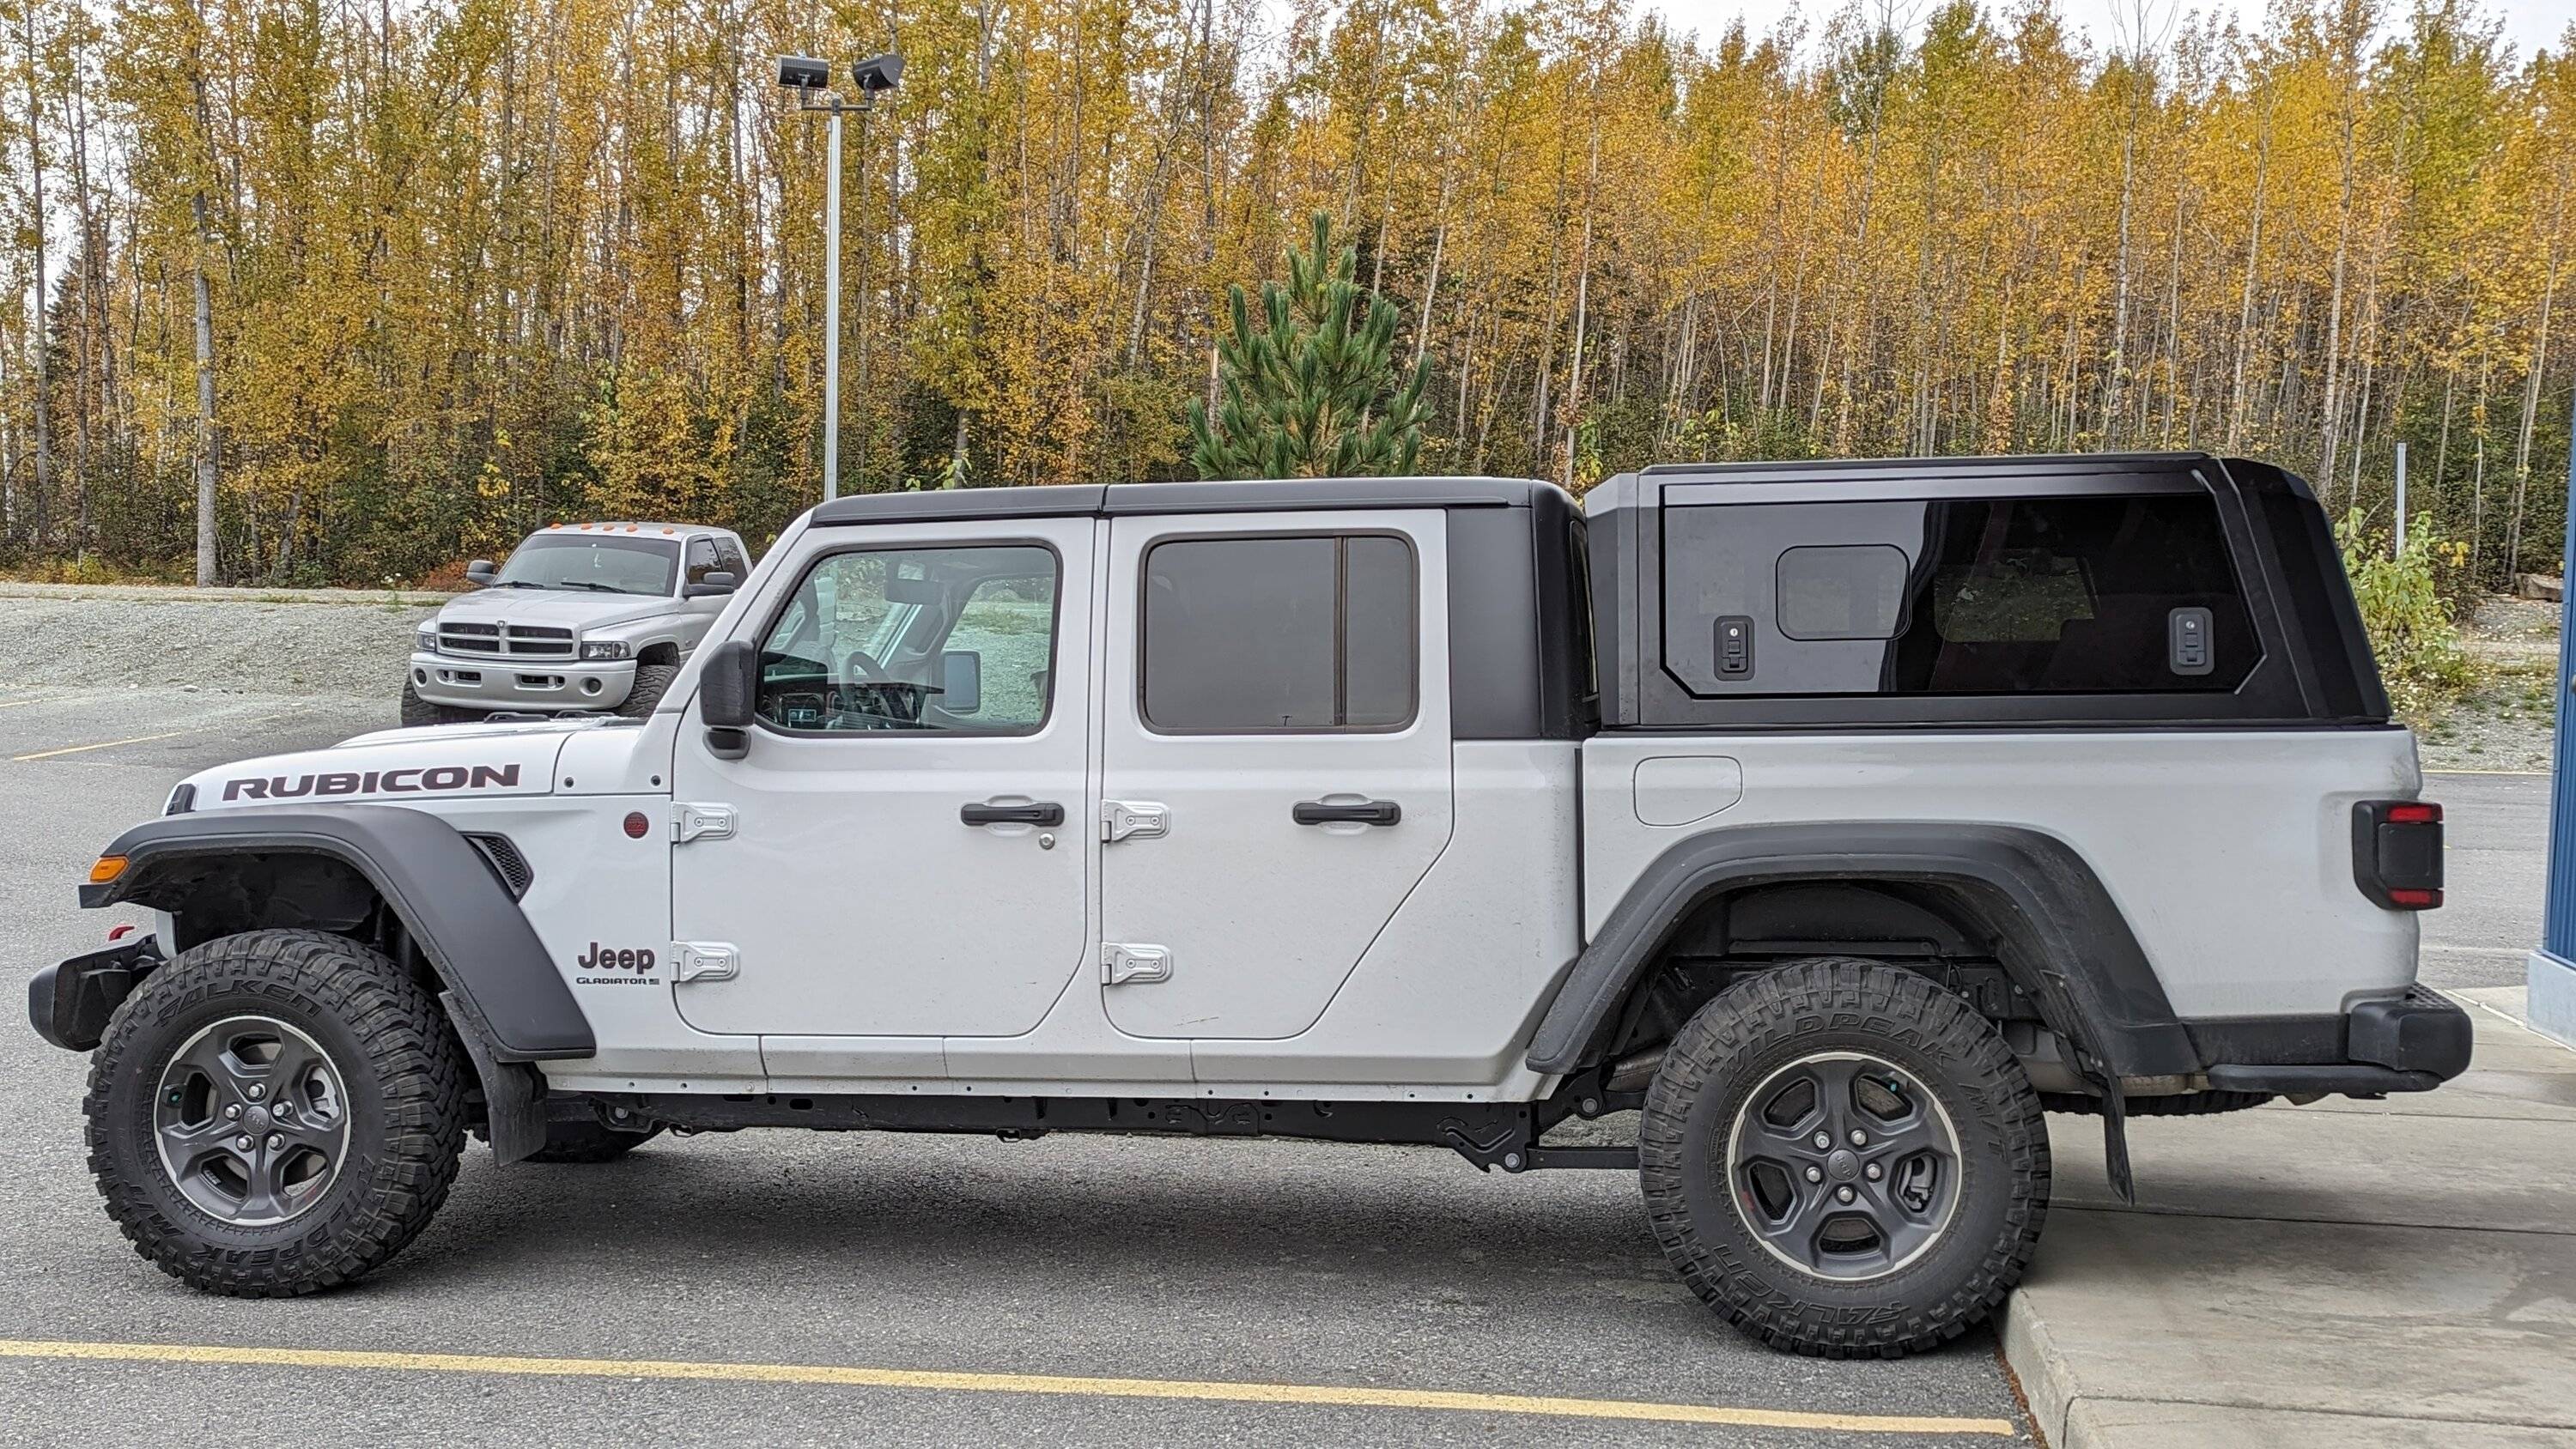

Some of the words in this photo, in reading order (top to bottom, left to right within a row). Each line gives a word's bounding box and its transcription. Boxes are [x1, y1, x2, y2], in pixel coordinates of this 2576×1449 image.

[222, 764, 521, 801] RUBICON
[578, 942, 655, 974] Jeep
[1720, 1013, 1957, 1087] WILDPEAK
